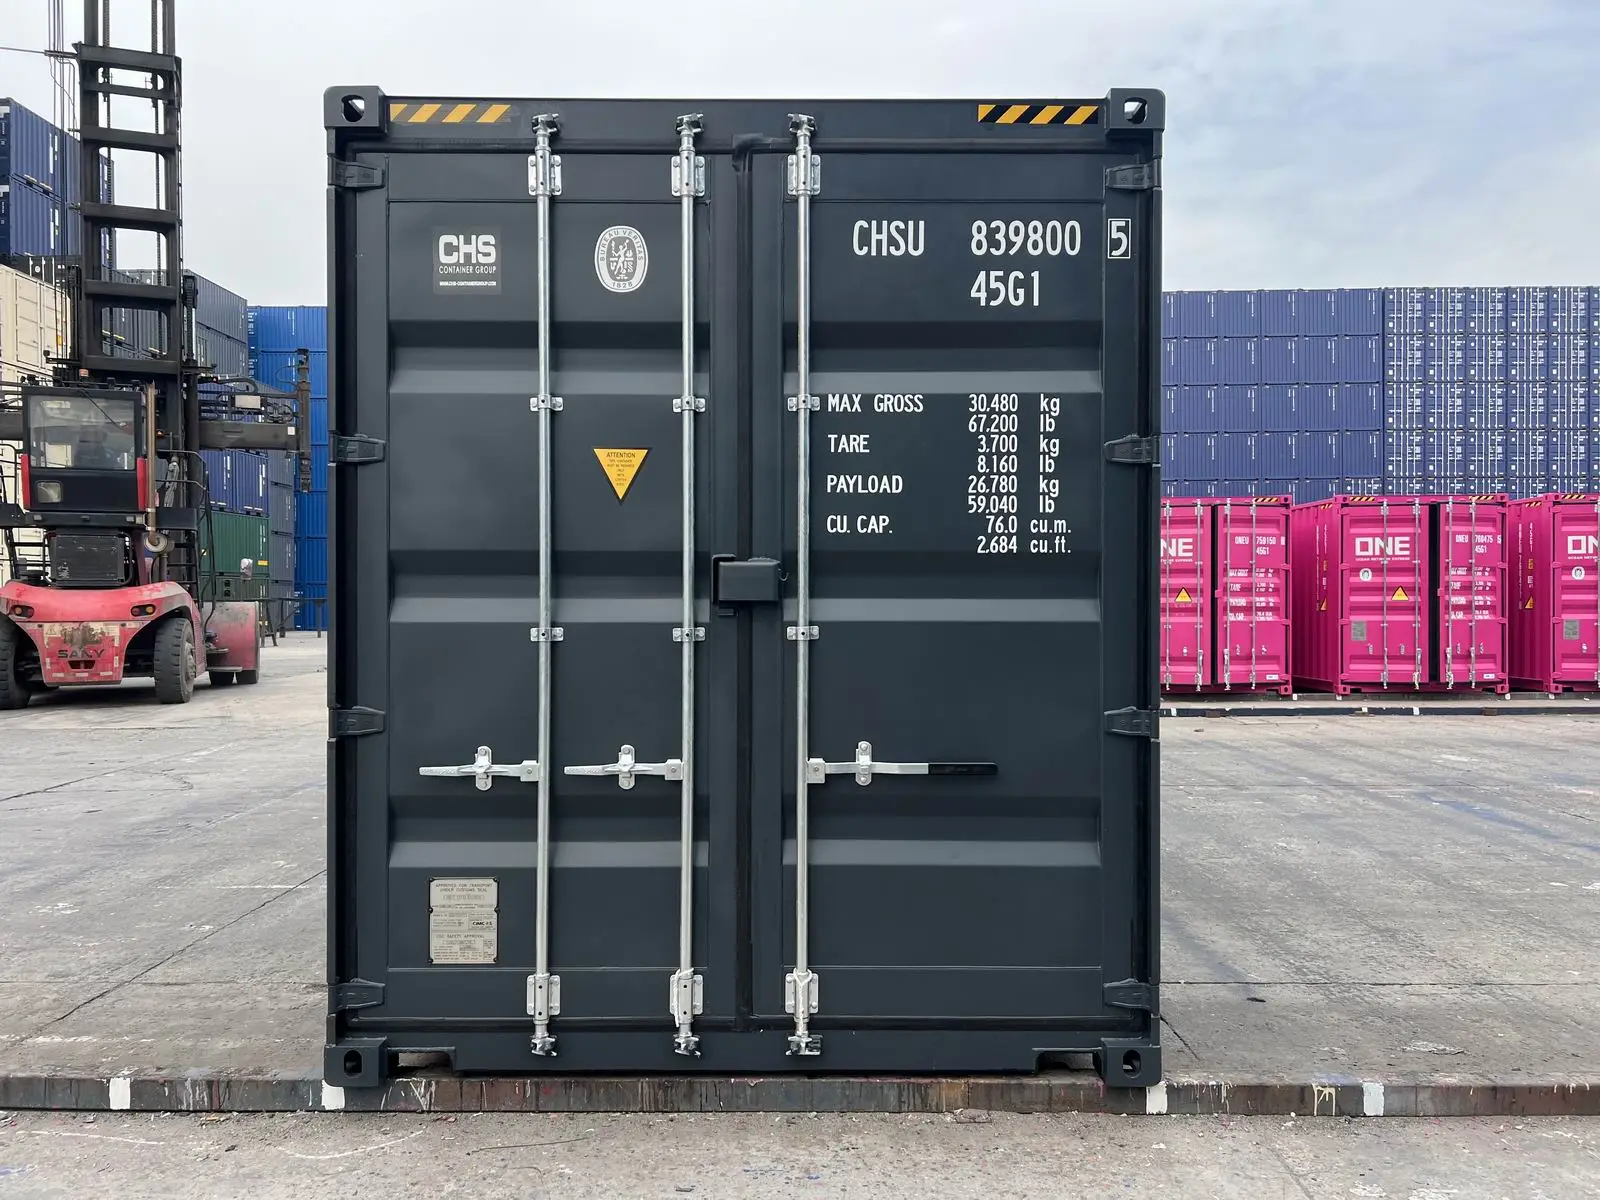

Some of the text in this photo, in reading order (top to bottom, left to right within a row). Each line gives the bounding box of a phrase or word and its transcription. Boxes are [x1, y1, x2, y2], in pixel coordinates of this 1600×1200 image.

[600, 230, 644, 262] BUREAU VERITAS
[853, 219, 1129, 256] CHSU 839800 5
[439, 234, 496, 264] CHS
[439, 265, 497, 274] CONTAINER GROUP
[612, 281, 633, 289] 1828
[971, 270, 1039, 307] 45G1
[827, 395, 862, 413] MAX
[874, 395, 924, 413] GROSS
[1040, 394, 1060, 416] kg
[1040, 414, 1056, 432] lb
[828, 434, 870, 453] TARE
[1040, 434, 1060, 457] kg
[1039, 455, 1055, 473] lb
[827, 475, 903, 493] PAYLOAD
[1039, 475, 1060, 498] kg
[1039, 495, 1055, 513] lb
[827, 515, 1072, 534] CU. CAP. 76.0 cu.m.
[1030, 535, 1072, 554] cu.ft.
[1161, 538, 1193, 557] NE
[1355, 536, 1410, 555] ONE
[1567, 535, 1599, 555] ON
[57, 648, 104, 659] SANY
